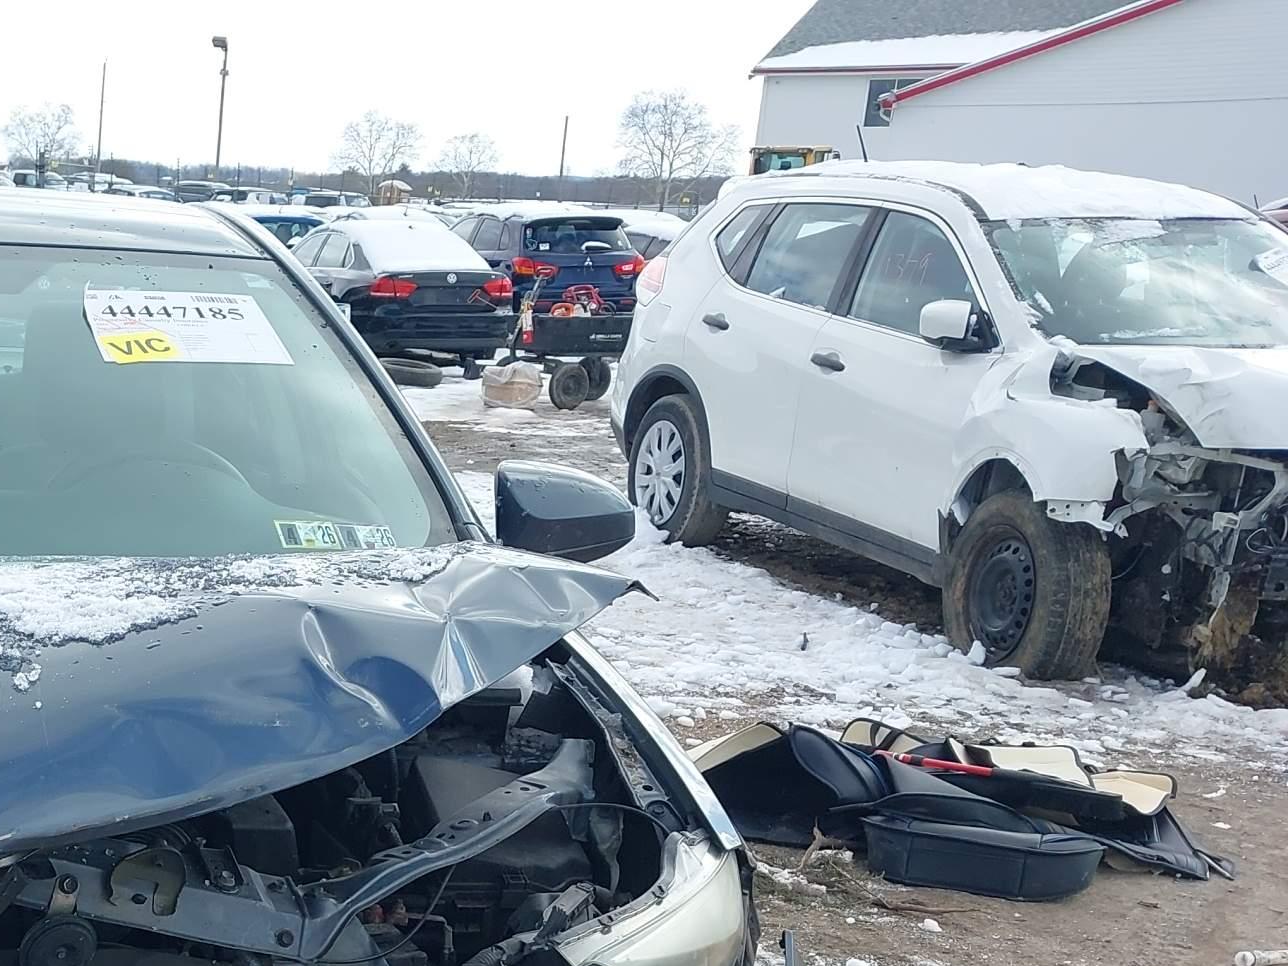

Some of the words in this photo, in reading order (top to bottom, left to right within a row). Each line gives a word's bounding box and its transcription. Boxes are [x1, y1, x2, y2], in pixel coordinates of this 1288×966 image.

[101, 304, 245, 320] 44447185
[107, 338, 171, 356] VIC
[317, 525, 337, 544] 26
[376, 528, 396, 547] 26
